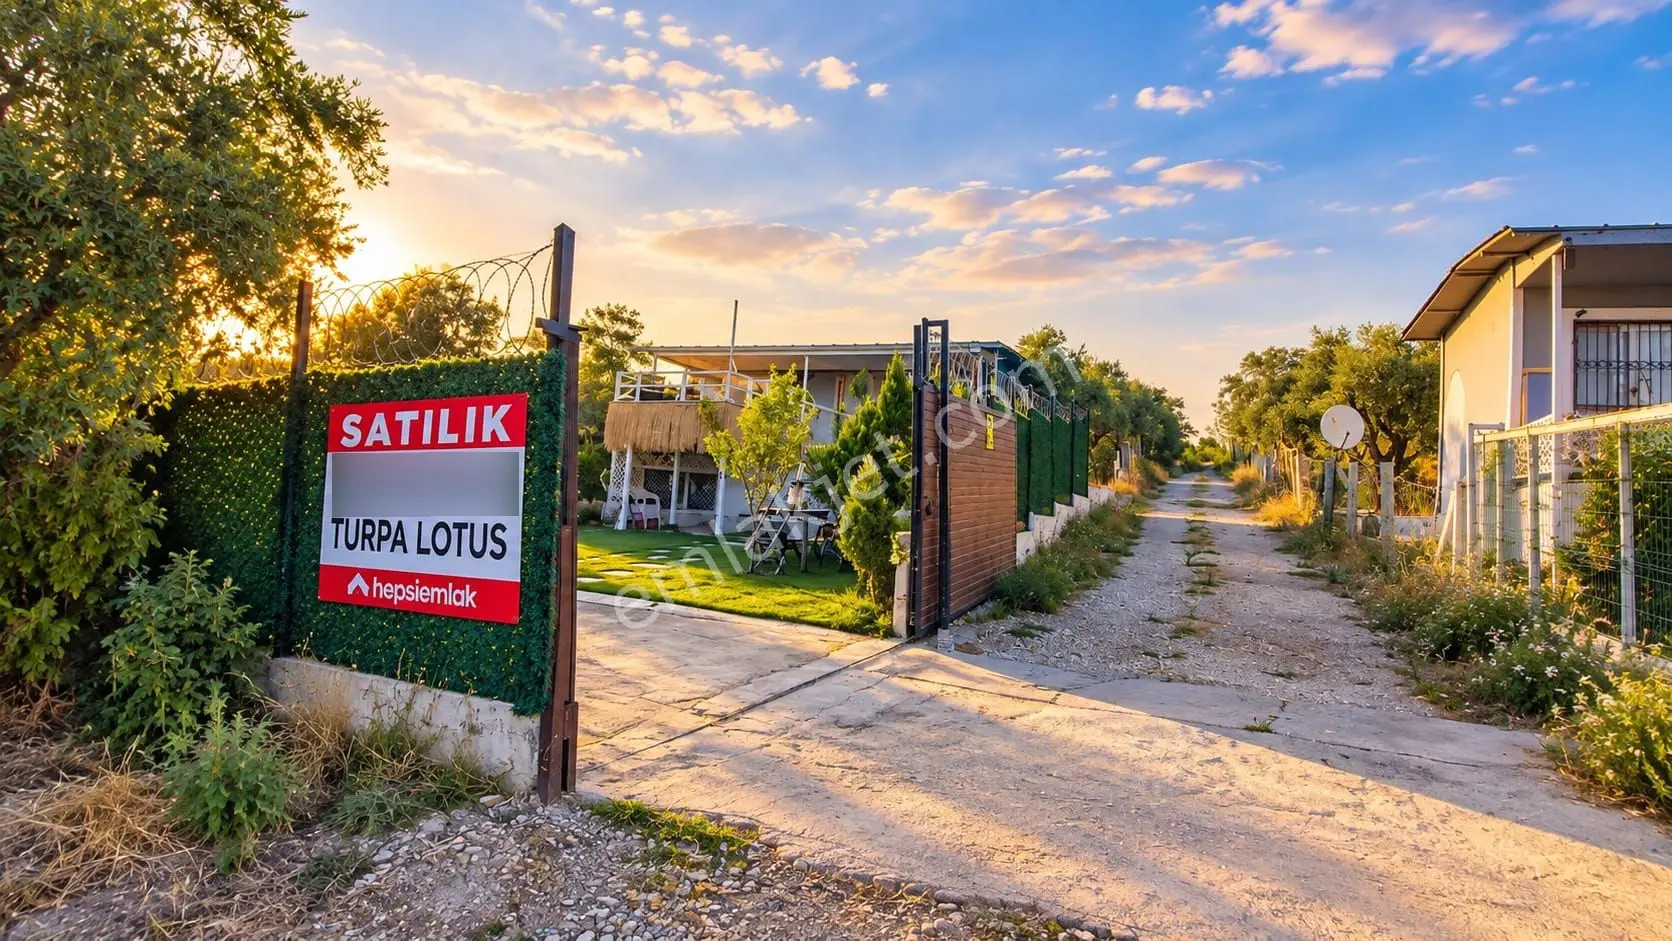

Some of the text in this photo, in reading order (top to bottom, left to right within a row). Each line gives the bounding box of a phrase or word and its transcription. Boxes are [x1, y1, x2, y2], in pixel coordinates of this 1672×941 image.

[340, 404, 512, 448] SATILIK
[331, 517, 508, 560] TURPA LOTUS
[372, 576, 477, 608] hepsiemlak
